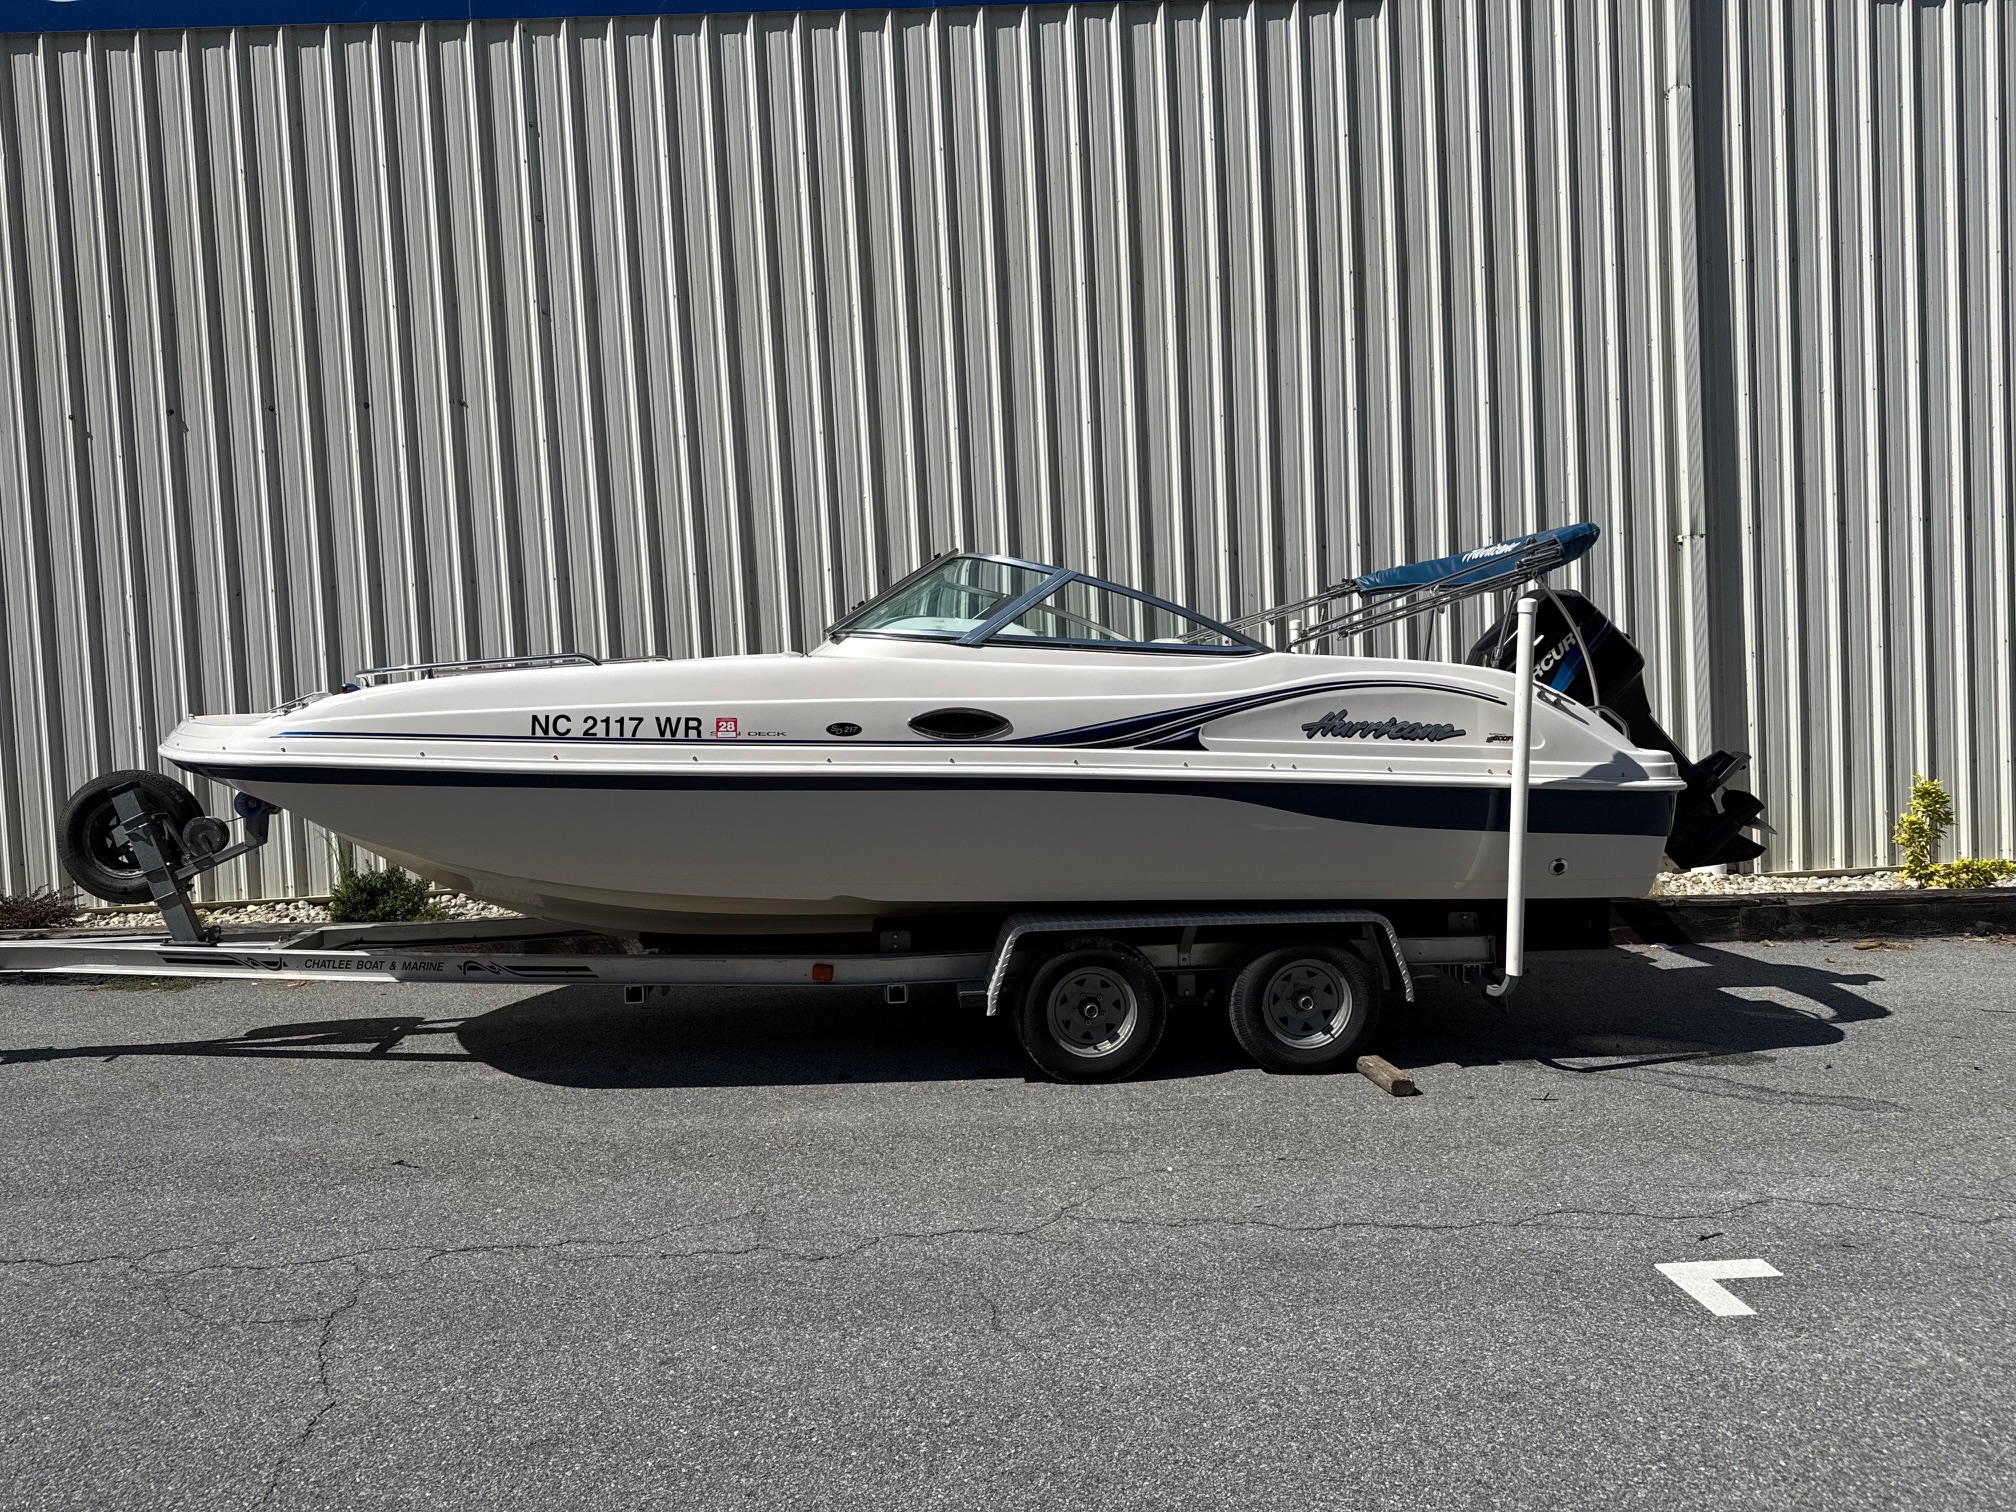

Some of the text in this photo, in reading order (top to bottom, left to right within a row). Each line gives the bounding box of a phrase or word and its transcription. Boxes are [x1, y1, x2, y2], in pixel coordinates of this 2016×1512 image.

[531, 714, 702, 738] NC 2117 WR
[718, 721, 735, 732] 28
[830, 724, 858, 735] SD 217
[1301, 708, 1467, 743] Hurricane
[304, 959, 444, 972] CHATLEE BOAT & MARINE
